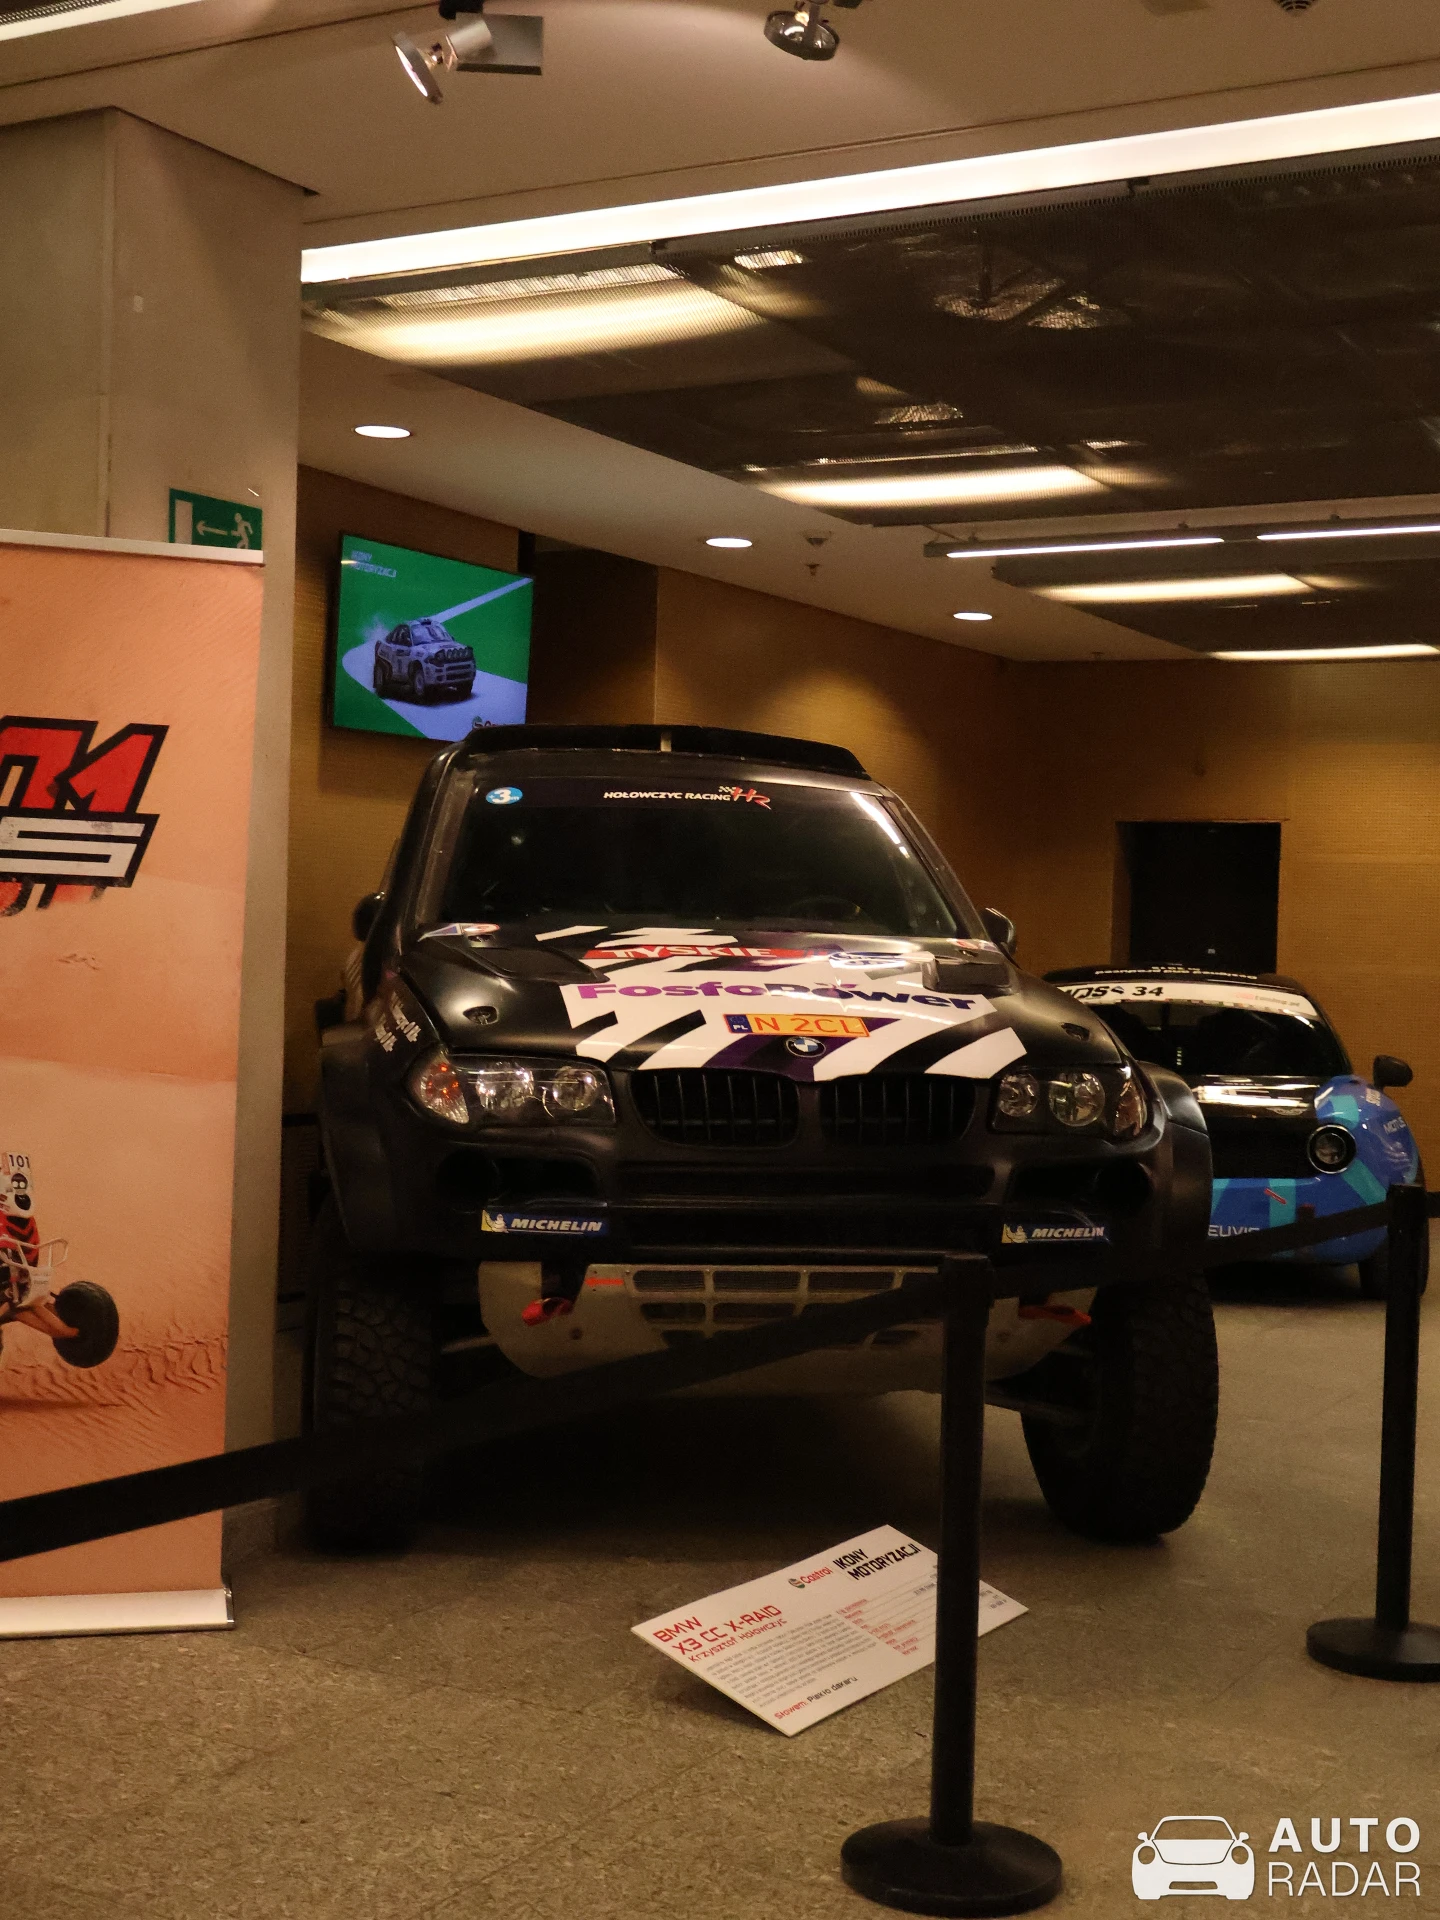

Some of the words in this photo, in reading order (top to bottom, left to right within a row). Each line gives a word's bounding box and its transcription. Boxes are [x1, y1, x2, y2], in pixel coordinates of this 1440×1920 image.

[685, 792, 731, 801] RACING
[601, 945, 778, 958] TYSKIE
[1132, 986, 1164, 997] 34
[754, 1016, 781, 1032] N
[791, 1017, 864, 1035] 2CL
[8, 1154, 31, 1169] 101
[511, 1218, 603, 1232] MICHELIN
[1031, 1226, 1105, 1238] MICHELIN
[832, 1548, 869, 1570] IKONY
[847, 1543, 922, 1581] MOTORYZACJI
[800, 1566, 834, 1585] Castrol
[653, 1616, 703, 1643] BMW
[672, 1637, 703, 1656] X3
[699, 1626, 728, 1644] CC
[723, 1604, 782, 1633] X-RAID
[688, 1636, 739, 1663] Krzysztof
